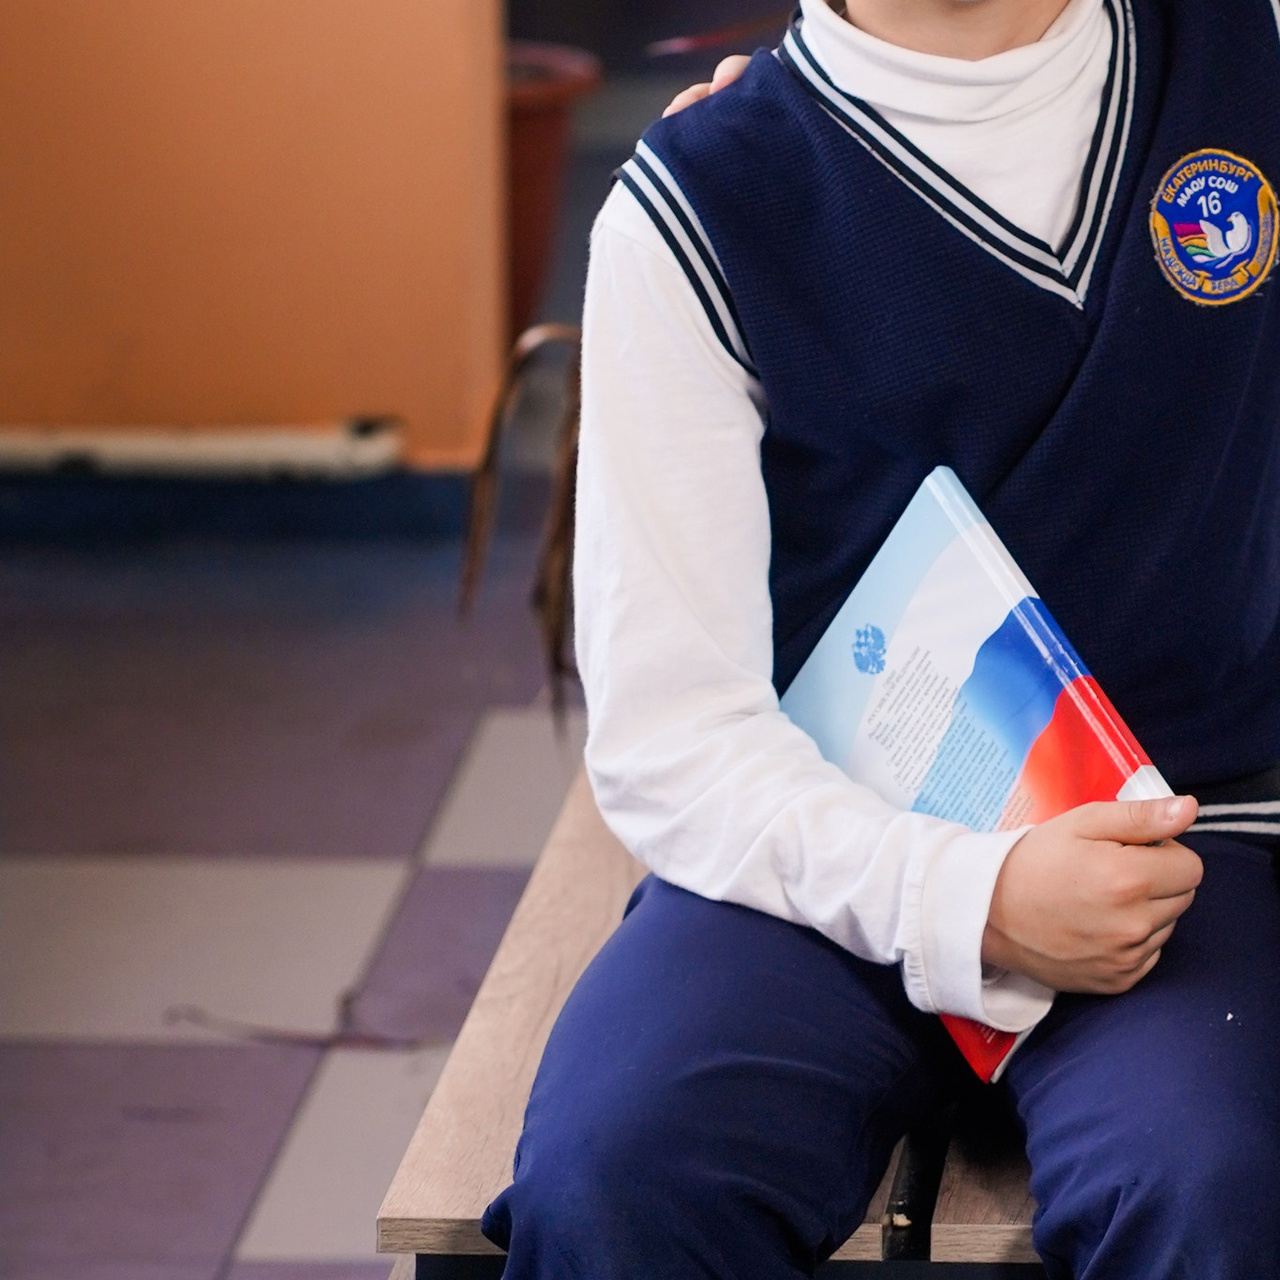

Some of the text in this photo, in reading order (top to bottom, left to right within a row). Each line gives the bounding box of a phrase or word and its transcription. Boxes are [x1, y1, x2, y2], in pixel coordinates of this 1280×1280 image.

[1162, 159, 1254, 203] ЕКАТЕРИНБУРГ
[1177, 175, 1239, 207] МАОУ СОШ
[1197, 191, 1222, 218] 16
